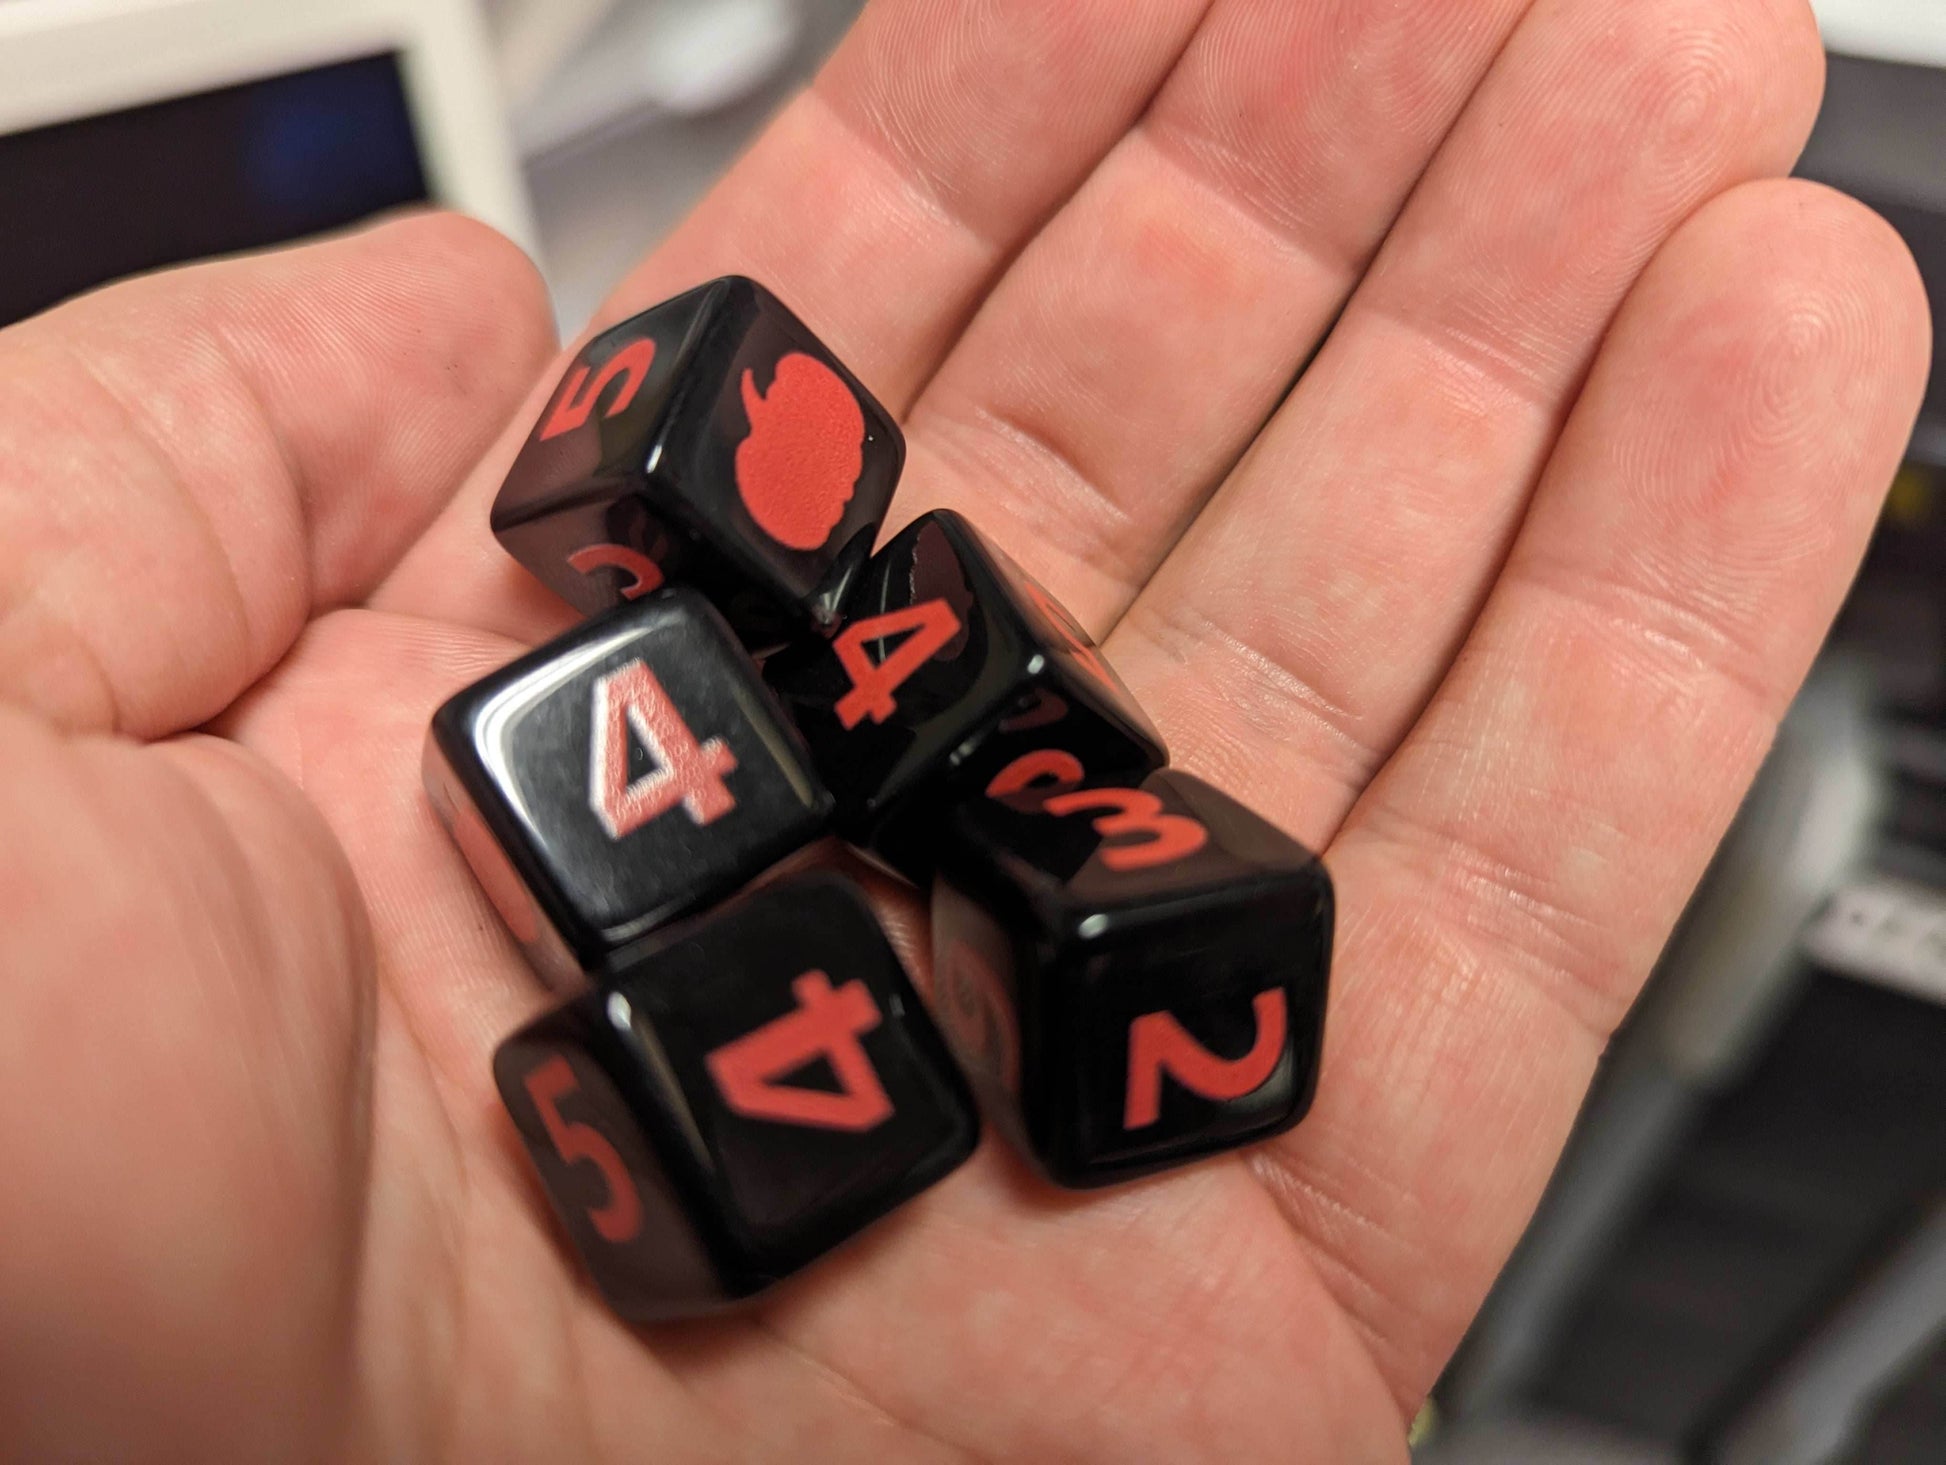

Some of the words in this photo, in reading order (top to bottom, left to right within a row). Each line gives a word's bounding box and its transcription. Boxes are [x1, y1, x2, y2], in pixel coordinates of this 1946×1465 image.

[540, 337, 657, 442] 5
[837, 598, 963, 732] 4
[590, 657, 738, 841] 4
[1042, 787, 1208, 871] 3
[706, 969, 896, 1136] 4
[1122, 986, 1288, 1131] 2
[525, 1055, 642, 1244] 5
